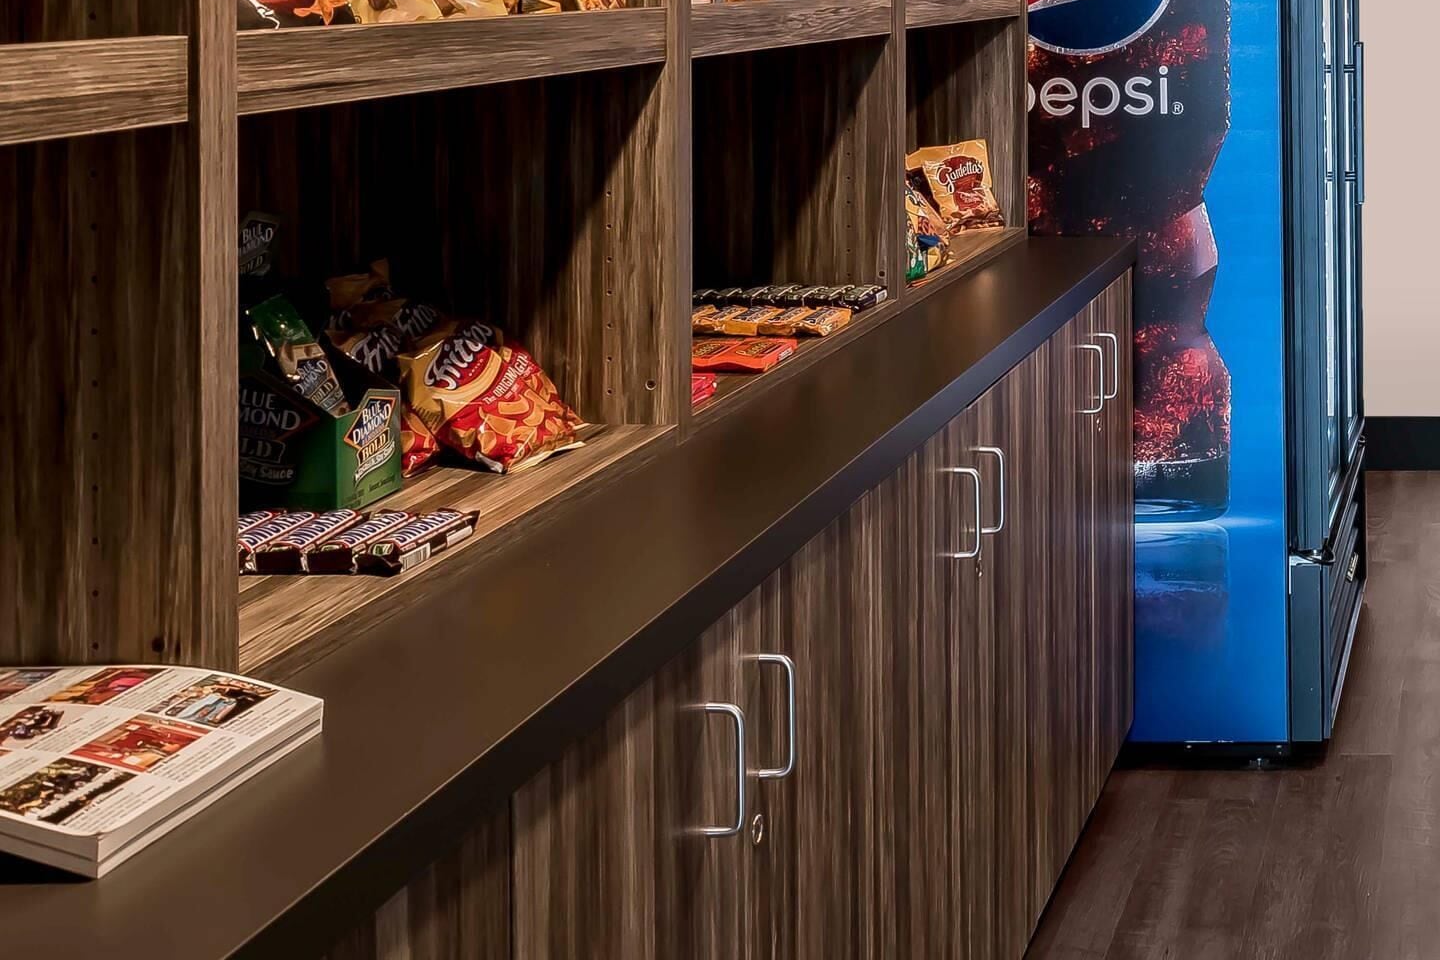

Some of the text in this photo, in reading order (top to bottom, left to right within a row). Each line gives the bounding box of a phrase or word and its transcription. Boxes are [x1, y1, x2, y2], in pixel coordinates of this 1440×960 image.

[1028, 66, 1168, 128] epsi
[936, 160, 985, 194] Gardetto's
[424, 320, 495, 390] Fritos
[352, 403, 392, 446] DIAMOND
[362, 400, 383, 426] BLUE
[361, 433, 387, 461] BOLD
